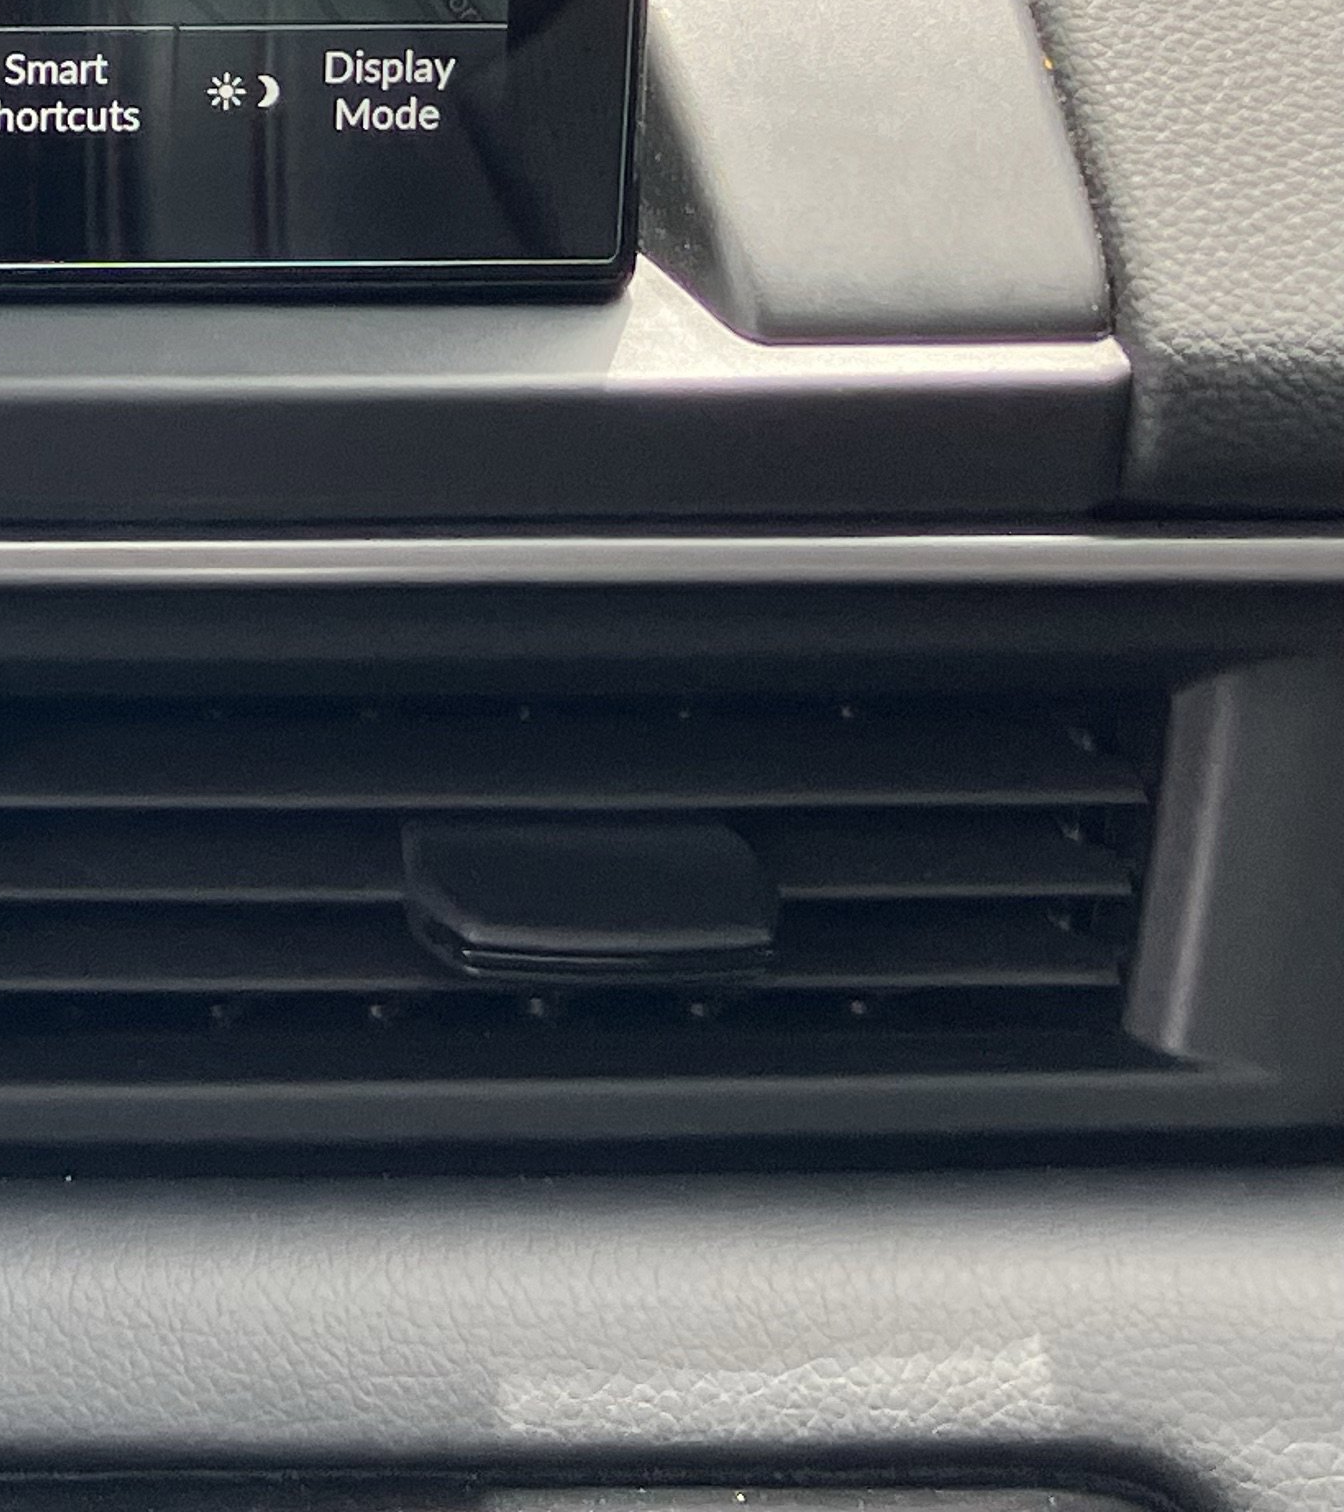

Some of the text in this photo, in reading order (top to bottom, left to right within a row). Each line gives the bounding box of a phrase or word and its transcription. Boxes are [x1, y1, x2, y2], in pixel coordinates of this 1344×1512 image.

[4, 53, 109, 87] Smart
[324, 49, 457, 90] Display
[335, 96, 441, 131] Mode
